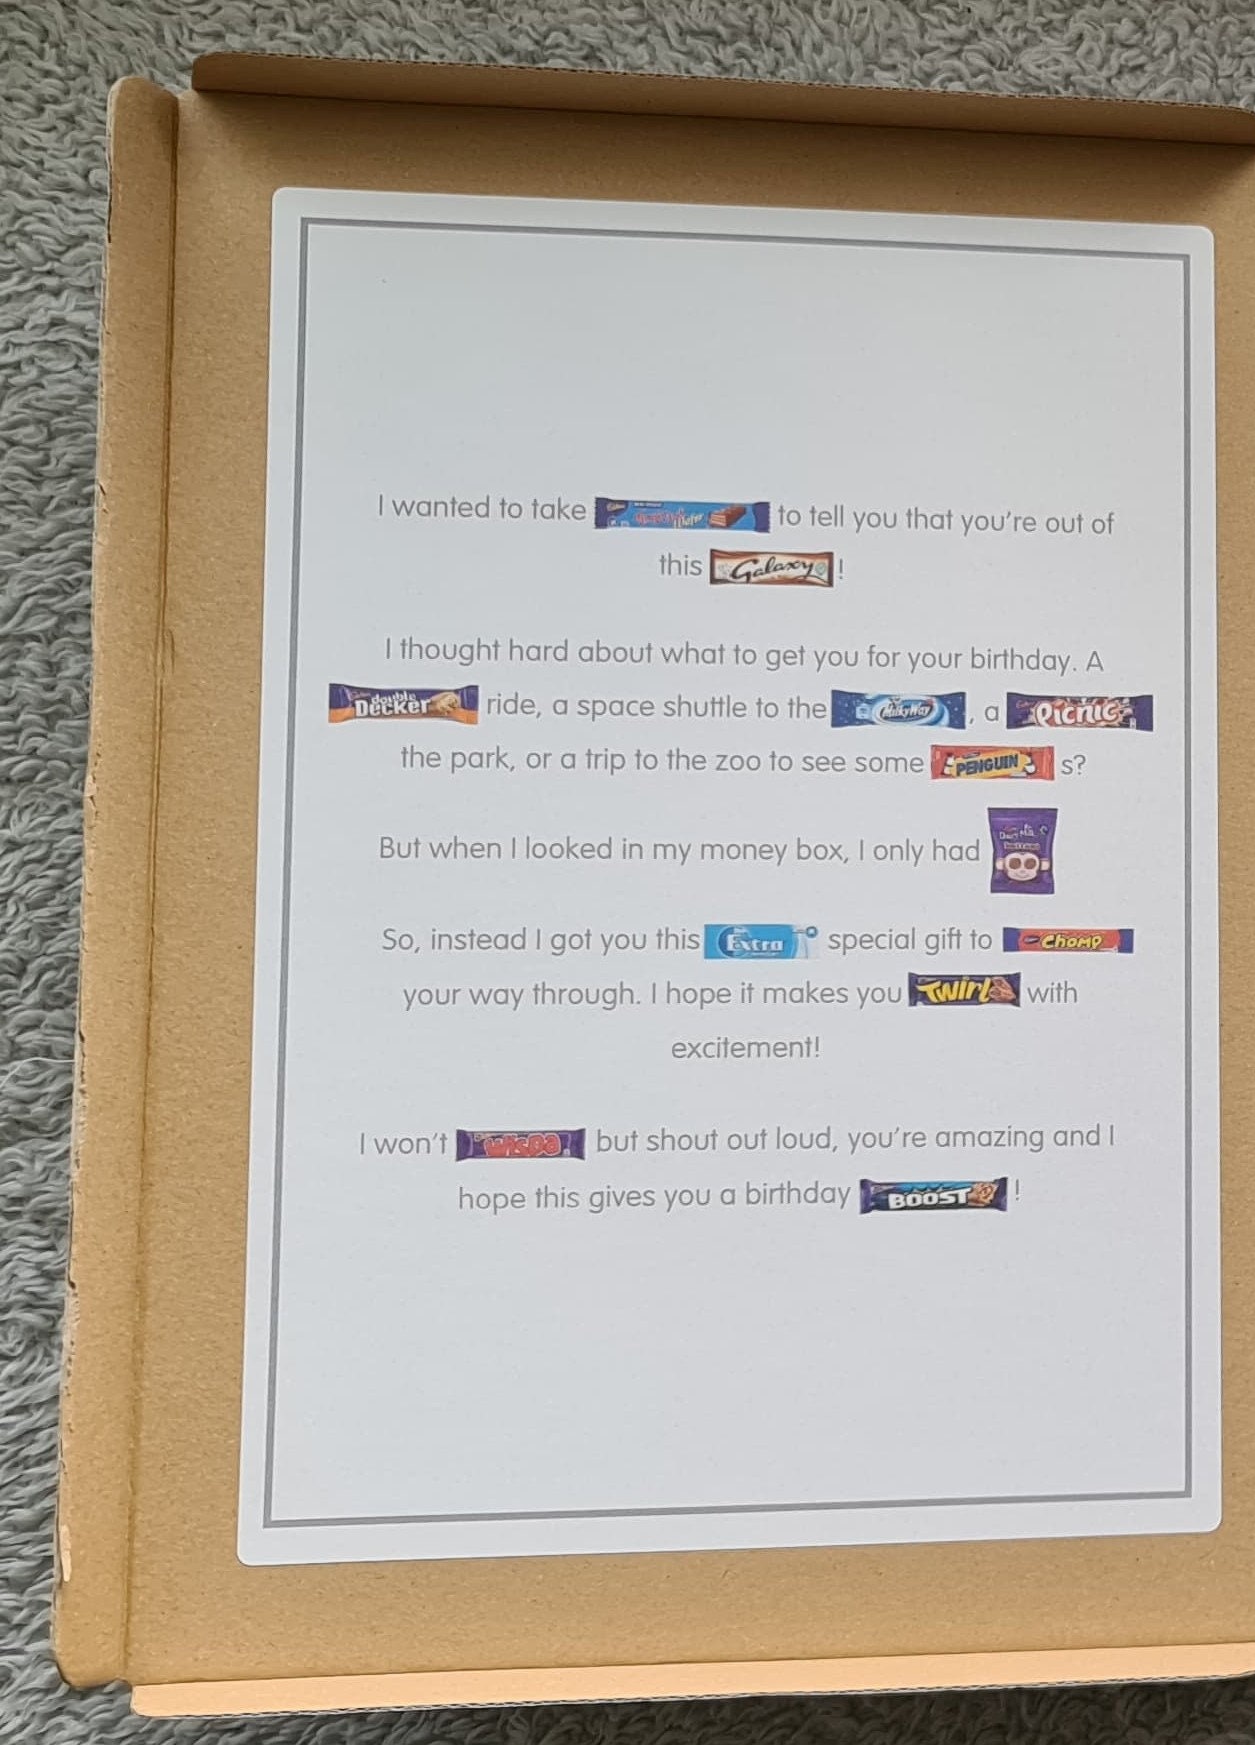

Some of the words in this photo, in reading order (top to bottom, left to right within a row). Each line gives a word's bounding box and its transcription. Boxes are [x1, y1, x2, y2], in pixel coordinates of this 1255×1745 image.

[379, 494, 383, 516] I
[392, 495, 489, 518] wanted
[499, 497, 522, 518] to
[532, 497, 586, 520] take
[778, 505, 801, 526] to
[809, 505, 843, 527] tell
[853, 511, 897, 533] you
[906, 507, 953, 530] that
[961, 511, 1036, 537] you're
[1046, 514, 1083, 533] out
[1092, 512, 1114, 534] of
[660, 552, 702, 576] this
[731, 556, 816, 583] Galaxy
[387, 638, 390, 659] I
[400, 636, 500, 666] thought
[510, 638, 568, 662] hard
[578, 639, 652, 663] about
[661, 641, 725, 665] what
[733, 644, 757, 665] to
[766, 645, 805, 671] get
[814, 651, 858, 672] you
[867, 645, 900, 669] for
[909, 651, 963, 674] your
[971, 646, 1076, 677] birthday.
[1086, 651, 1104, 671] A
[355, 700, 430, 717] Decker
[488, 692, 541, 718] ride,
[553, 699, 568, 715] a
[577, 700, 655, 722] space
[664, 694, 747, 718] shuttle
[756, 697, 779, 718] to
[788, 696, 827, 719] the
[984, 708, 999, 722] a
[1034, 700, 1121, 726] Picnic
[401, 745, 441, 768] the
[451, 746, 515, 774] park,
[526, 753, 552, 769] or
[561, 753, 576, 769] a
[585, 748, 625, 776] trip
[635, 749, 658, 770] to
[667, 747, 707, 770] the
[716, 755, 761, 771] zoo
[769, 751, 793, 771] to
[802, 756, 846, 772] see
[855, 756, 924, 772] some
[956, 754, 1019, 777] PENGUIN
[1060, 754, 1086, 775] s?
[380, 837, 421, 858] But
[429, 835, 501, 859] when
[512, 837, 515, 859] I
[526, 836, 612, 859] looked
[623, 838, 643, 859] in
[654, 843, 691, 866] my
[701, 844, 787, 866] money
[797, 837, 848, 864] box,
[860, 839, 863, 861] I
[873, 838, 923, 867] only
[933, 838, 979, 861] had
[382, 928, 420, 953] So,
[432, 927, 526, 950] instead
[536, 928, 540, 950] I
[551, 929, 592, 956] got
[601, 934, 646, 956] you
[656, 926, 700, 950] this
[724, 934, 785, 952] Extra
[828, 927, 915, 955] special
[925, 927, 962, 955] gift
[970, 929, 992, 950] to
[403, 989, 461, 1011] your
[469, 988, 524, 1011] way
[533, 981, 640, 1011] through.
[652, 982, 656, 1004] I
[667, 981, 731, 1010] hope
[741, 982, 754, 1003] it
[764, 981, 848, 1003] makes
[857, 986, 901, 1010] you
[916, 976, 992, 1003] Twirl
[1027, 980, 1078, 1003] with
[672, 1036, 819, 1058] excitement!
[361, 1133, 364, 1155] I
[374, 1133, 447, 1154] won't
[597, 1129, 638, 1152] but
[647, 1128, 718, 1151] shout
[728, 1129, 767, 1150] out
[776, 1126, 837, 1152] loud,
[848, 1127, 926, 1155] you're
[936, 1125, 1043, 1153] amazing
[1053, 1123, 1100, 1146] and
[1110, 1125, 1114, 1146] I
[459, 1187, 525, 1215] hope
[535, 1185, 579, 1208] this
[589, 1185, 655, 1214] gives
[664, 1189, 710, 1213] you
[720, 1189, 735, 1205] a
[746, 1181, 851, 1209] birthday
[888, 1188, 971, 1210] BOOST
